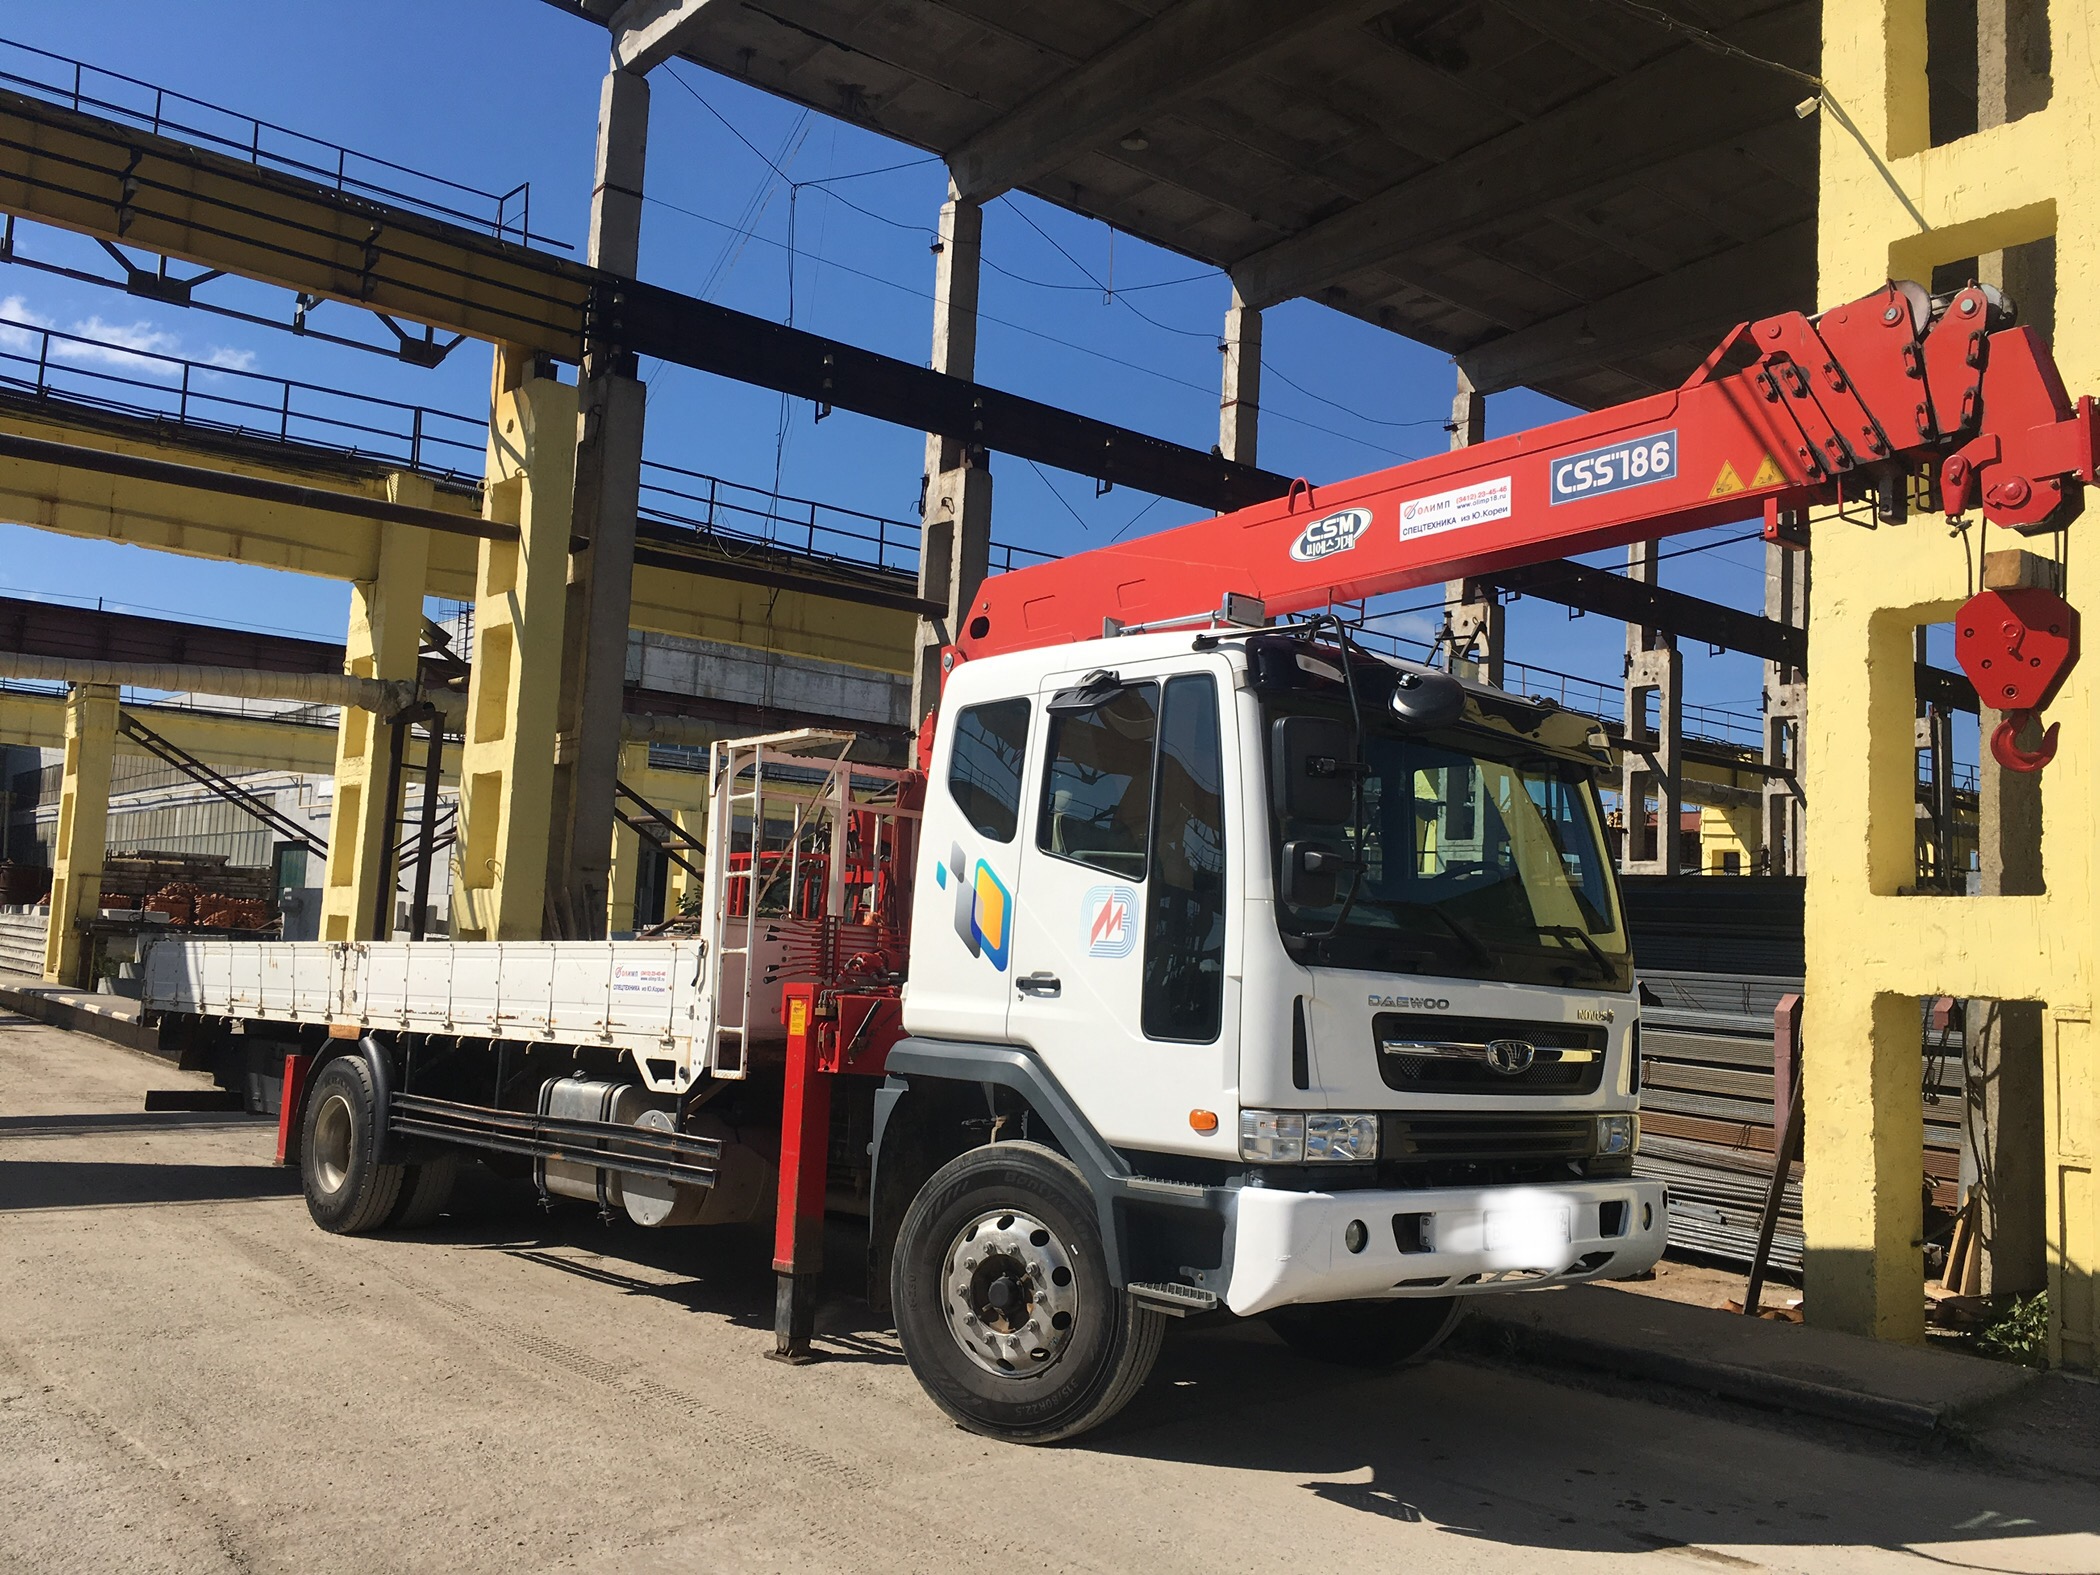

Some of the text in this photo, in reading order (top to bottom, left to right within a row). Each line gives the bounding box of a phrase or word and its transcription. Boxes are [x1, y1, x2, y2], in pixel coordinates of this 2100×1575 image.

[1456, 485, 1507, 504] (3412) 23-45-46
[1456, 494, 1507, 509] www.olimp18.ru
[1402, 517, 1457, 536] СПЕЦТЕХНИКА
[1368, 994, 1450, 1010] DAEWOO
[1015, 1378, 1079, 1417] 315/80R22.5
